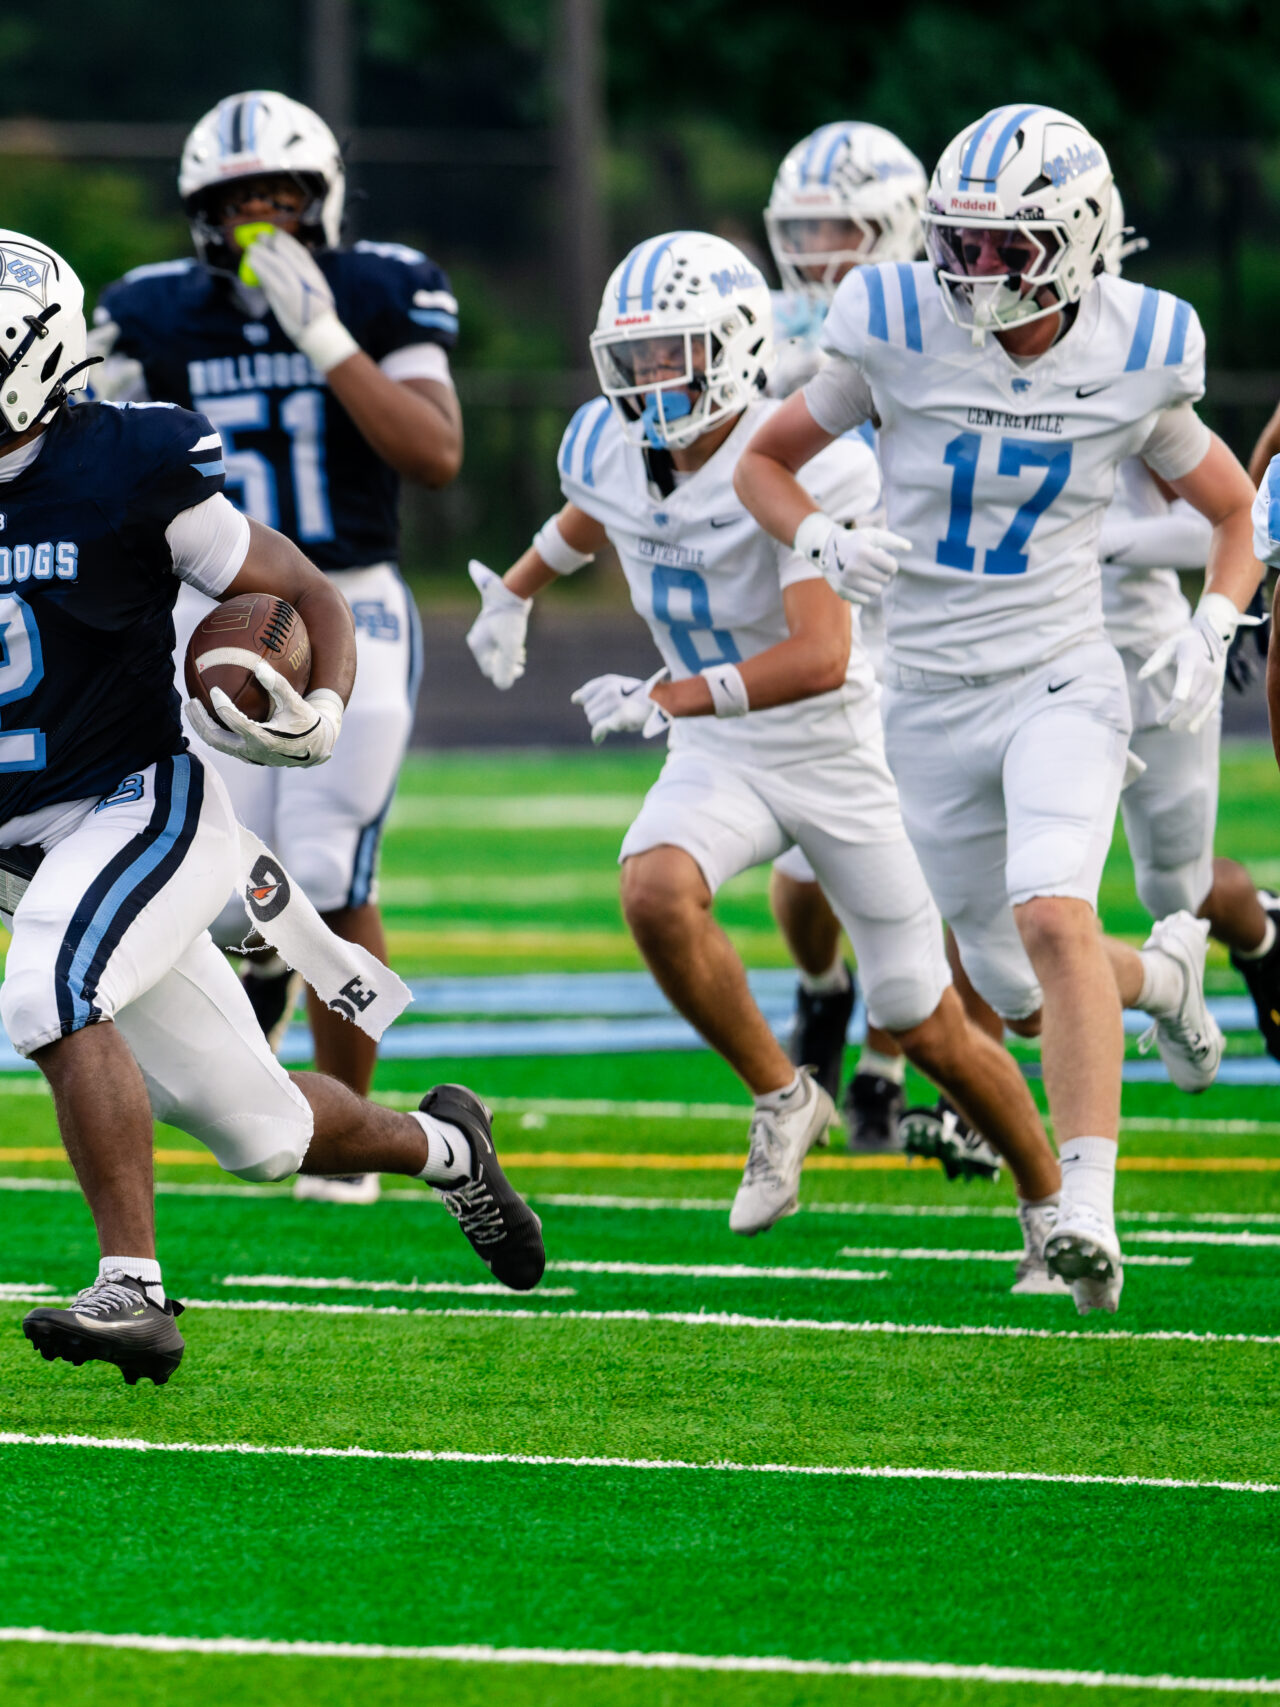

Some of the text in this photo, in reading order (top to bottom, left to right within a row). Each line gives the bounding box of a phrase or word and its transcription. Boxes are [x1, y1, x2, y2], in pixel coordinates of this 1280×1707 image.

[951, 197, 996, 212] Riddell
[194, 391, 336, 543] 51
[967, 407, 1064, 435] CENTREVILLE
[936, 431, 1074, 575] 17
[651, 564, 743, 675] 8
